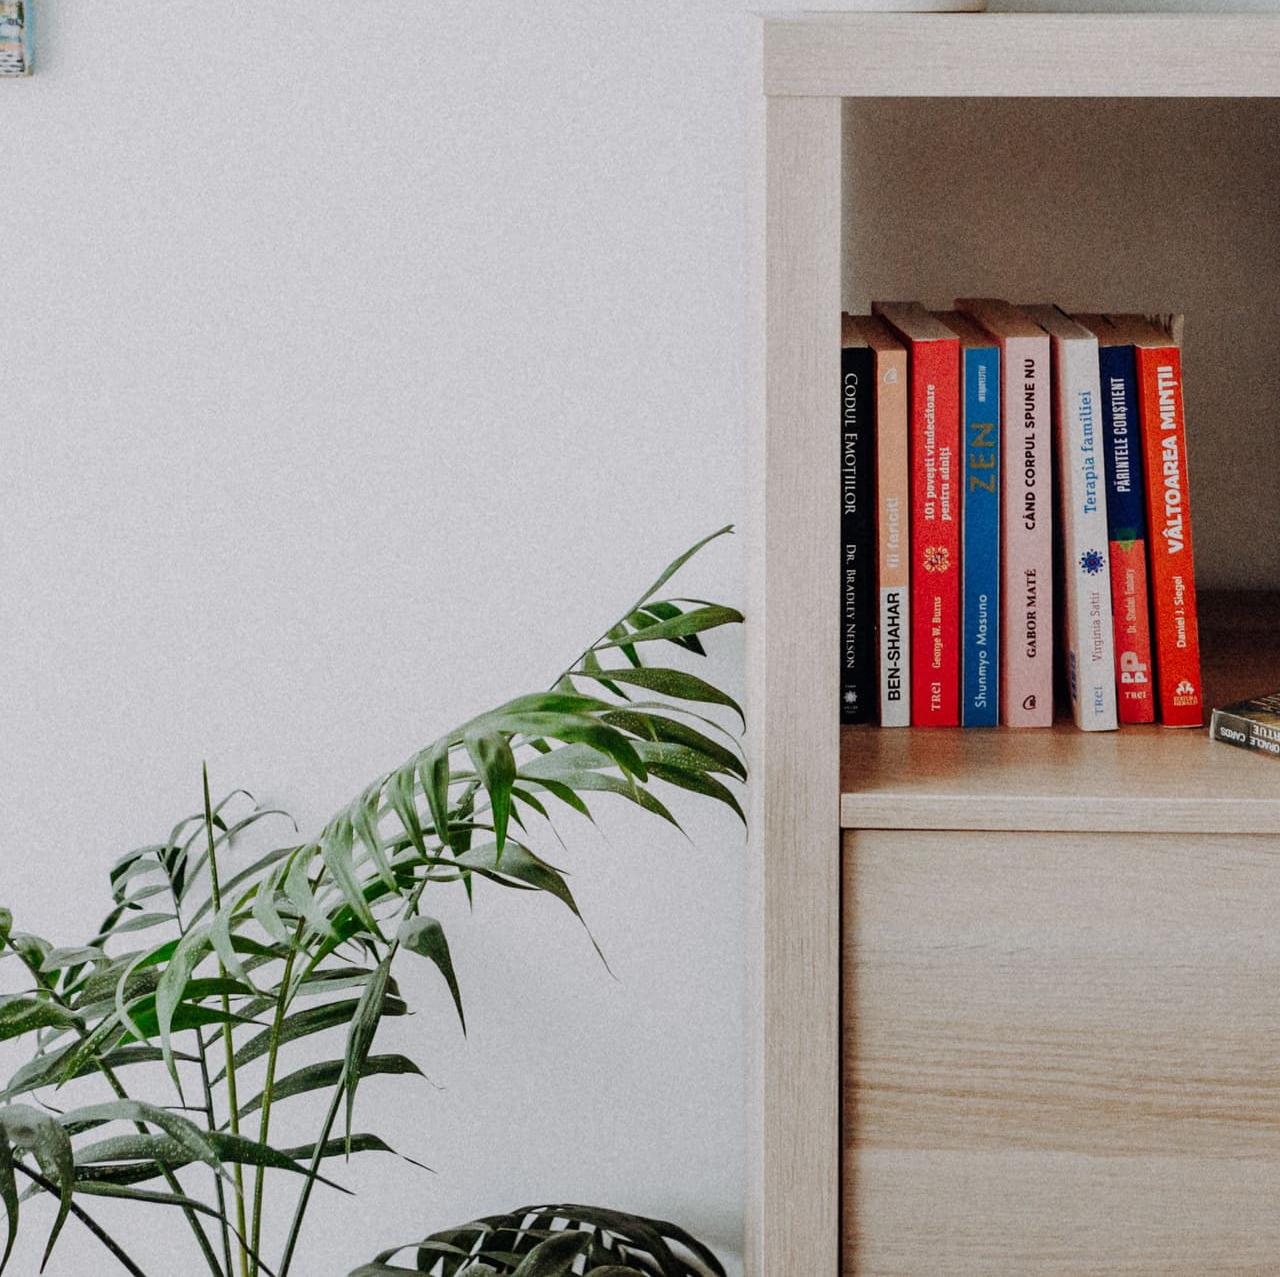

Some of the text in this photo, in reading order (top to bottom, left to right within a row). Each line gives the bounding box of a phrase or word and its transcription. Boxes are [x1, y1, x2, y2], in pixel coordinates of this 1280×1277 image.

[969, 423, 996, 493] ZEN
[1023, 359, 1035, 530] CÂND CORPUL SPUNE NU
[1079, 391, 1097, 513] Terapia familiei
[1114, 438, 1131, 493] PĂRINTELE
[925, 501, 934, 521] 101
[941, 483, 952, 521] pentru
[1161, 435, 1184, 554] VÂLTOAREA
[932, 596, 942, 623] Burns
[1173, 576, 1184, 605] Siegel
[888, 592, 900, 701] BEN-SHAHAR
[932, 638, 943, 668] George
[1026, 611, 1036, 658] GABOR
[1092, 619, 1104, 661] Virginia
[1175, 617, 1186, 648] Daniel
[975, 651, 989, 707] Shunmyo
[1220, 726, 1246, 742] CARDS
[1249, 736, 1280, 753] ORACLE
